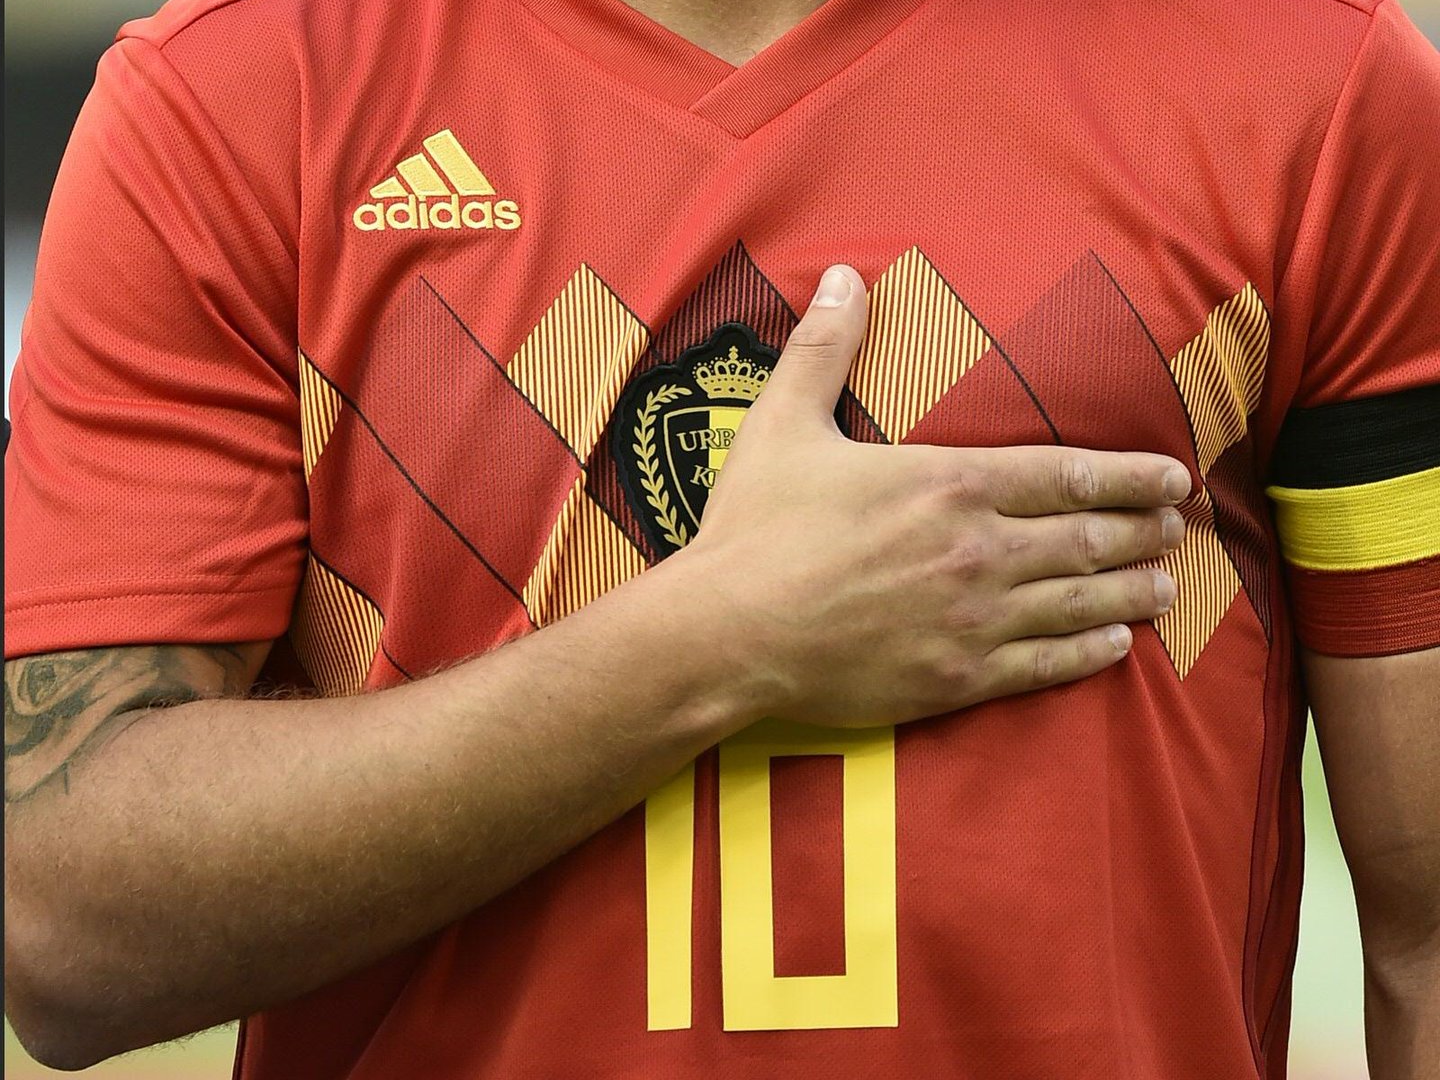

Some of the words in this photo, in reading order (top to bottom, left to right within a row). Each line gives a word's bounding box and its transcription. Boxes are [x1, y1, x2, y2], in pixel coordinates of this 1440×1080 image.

[352, 193, 522, 231] adidas
[690, 465, 720, 489] K
[645, 717, 899, 1032] 10
